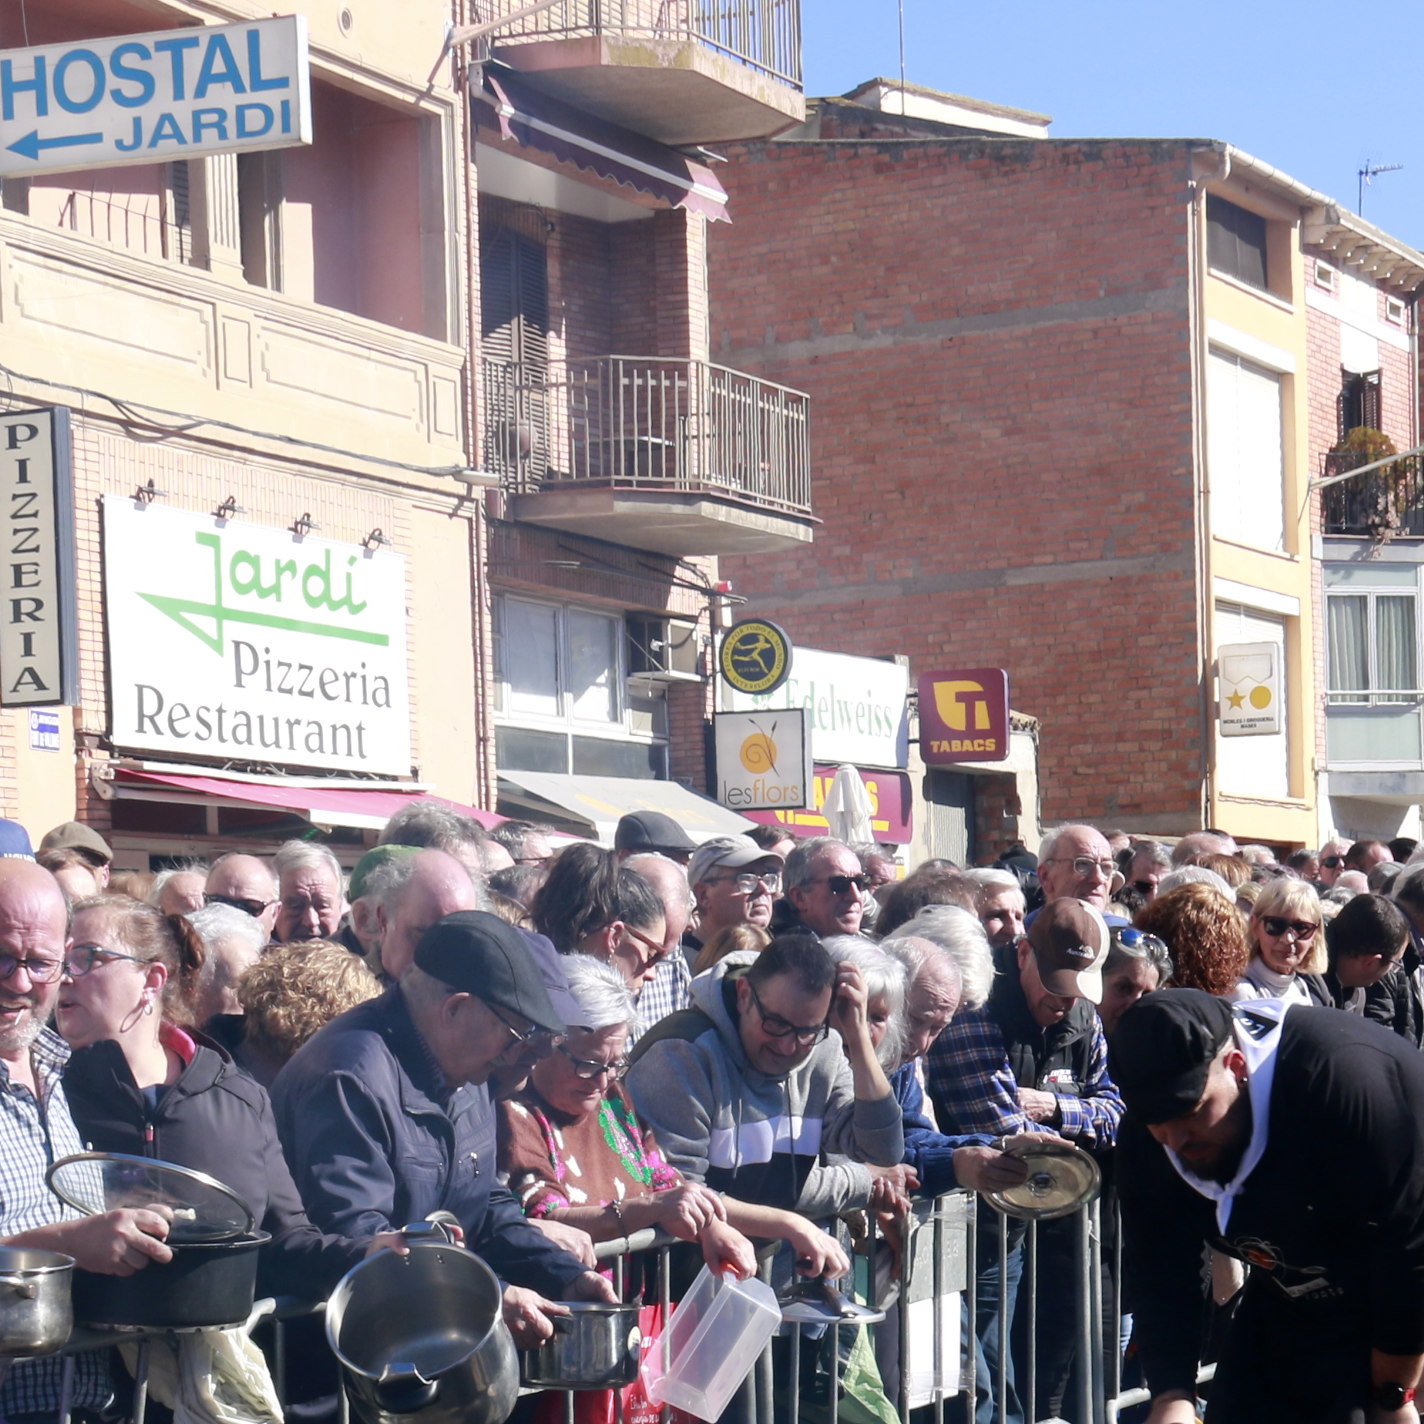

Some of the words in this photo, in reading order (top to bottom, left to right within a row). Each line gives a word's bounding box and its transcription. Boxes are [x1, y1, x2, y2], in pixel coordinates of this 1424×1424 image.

[0, 28, 291, 121] HOSTAL
[114, 99, 292, 152] JARDI
[4, 422, 50, 694] PIZZERIA
[231, 640, 392, 708] Pizzeria
[134, 683, 369, 760] Restaurant
[785, 678, 894, 739] Edelweiss
[930, 738, 996, 753] TABACS
[723, 778, 800, 806] lesflors
